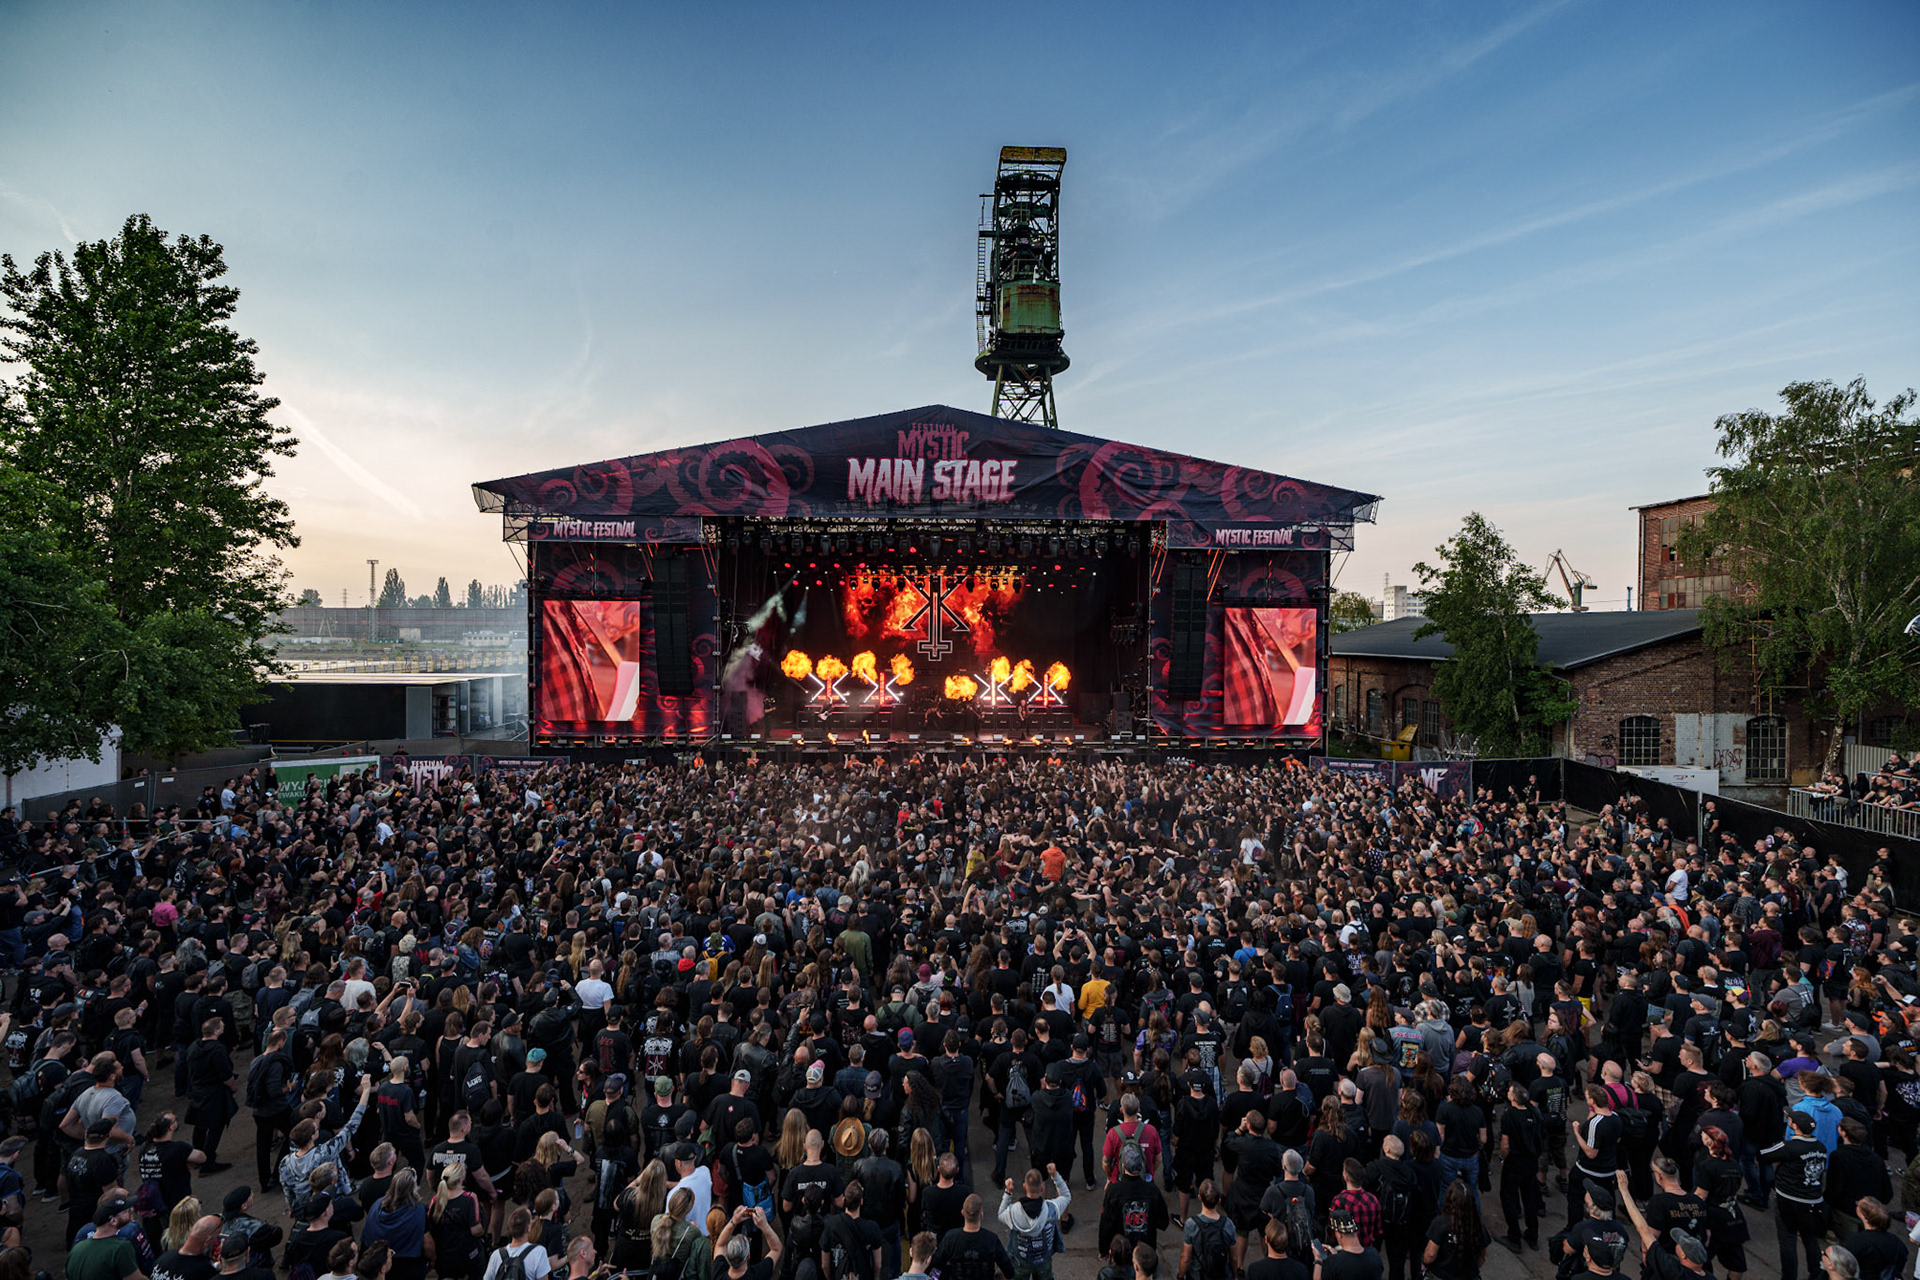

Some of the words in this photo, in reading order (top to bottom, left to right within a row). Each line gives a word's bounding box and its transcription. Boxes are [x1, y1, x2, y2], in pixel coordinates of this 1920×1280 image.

[911, 422, 957, 436] FESTIVAL
[897, 430, 969, 459] MYSTIC
[847, 457, 924, 507] MAIN
[932, 458, 1018, 505] STAGE
[552, 521, 593, 539] MYSTIC
[593, 520, 637, 539] FESTIVAL
[1215, 529, 1252, 546] MYSTIC
[1253, 528, 1294, 546] FESTIVAL
[411, 760, 444, 768] FESTIVAL
[1421, 767, 1448, 793] MF
